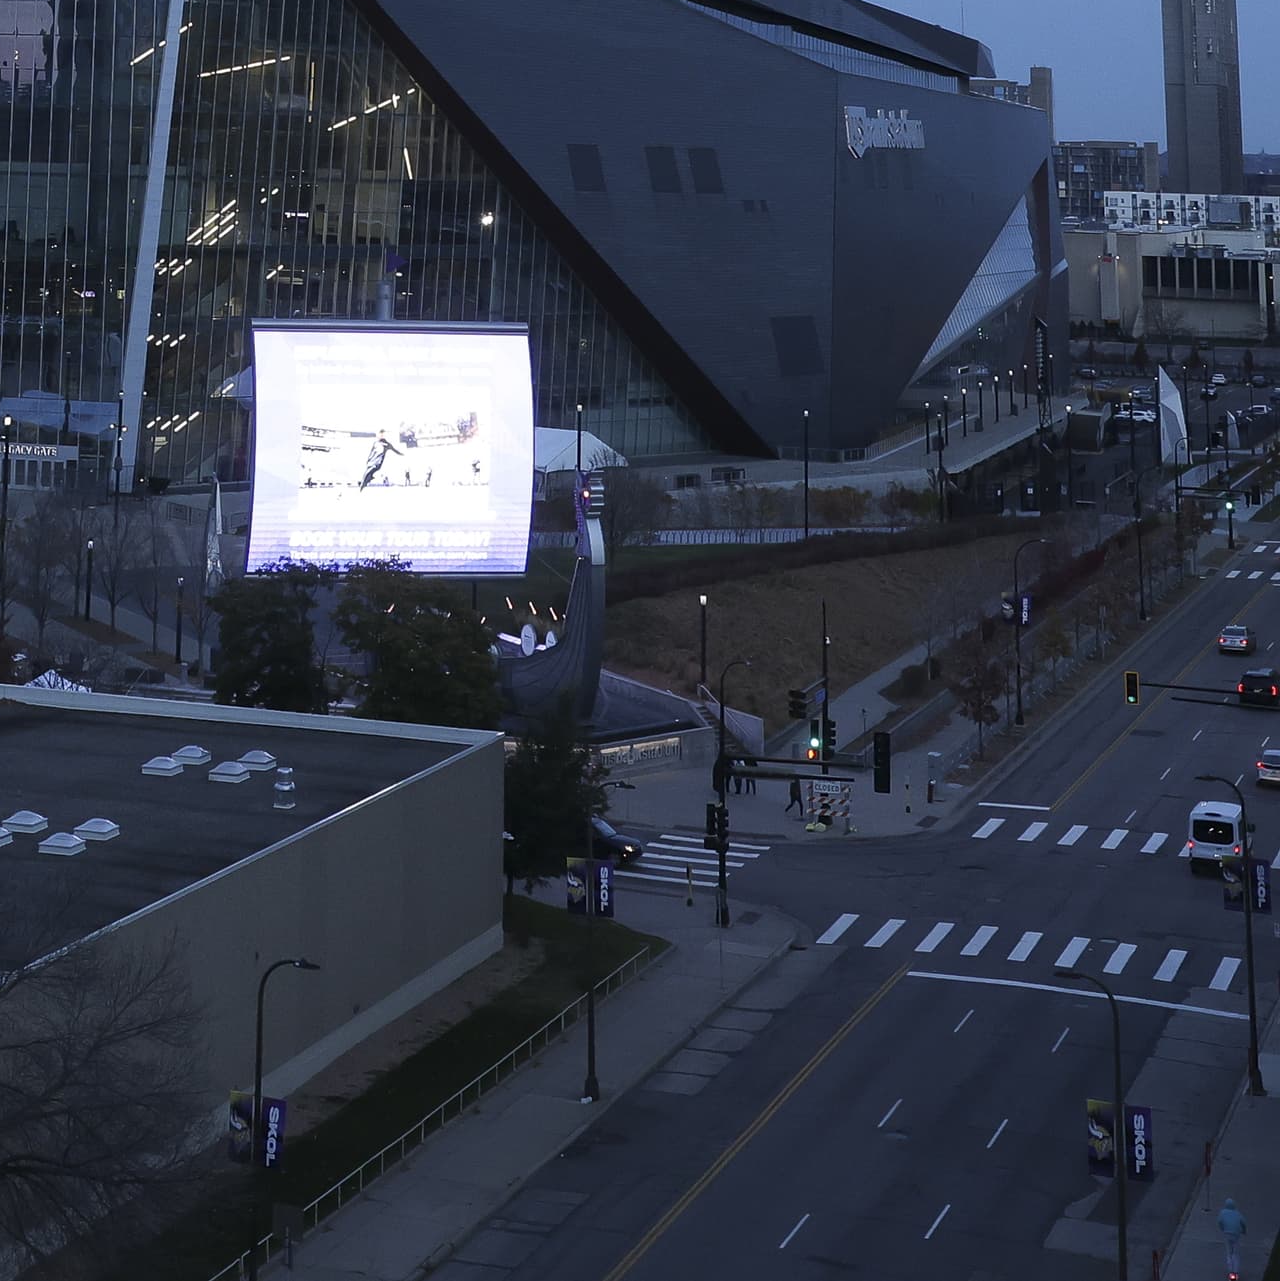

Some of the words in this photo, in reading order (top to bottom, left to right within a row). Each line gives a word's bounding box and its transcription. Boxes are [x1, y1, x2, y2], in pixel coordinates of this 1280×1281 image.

[33, 445, 57, 457] GATE
[814, 783, 840, 793] CLOSED
[600, 866, 609, 912] SKOL
[1256, 864, 1267, 909] SKOL
[266, 1106, 280, 1168] SKOL
[1133, 1113, 1147, 1174] SKOL
